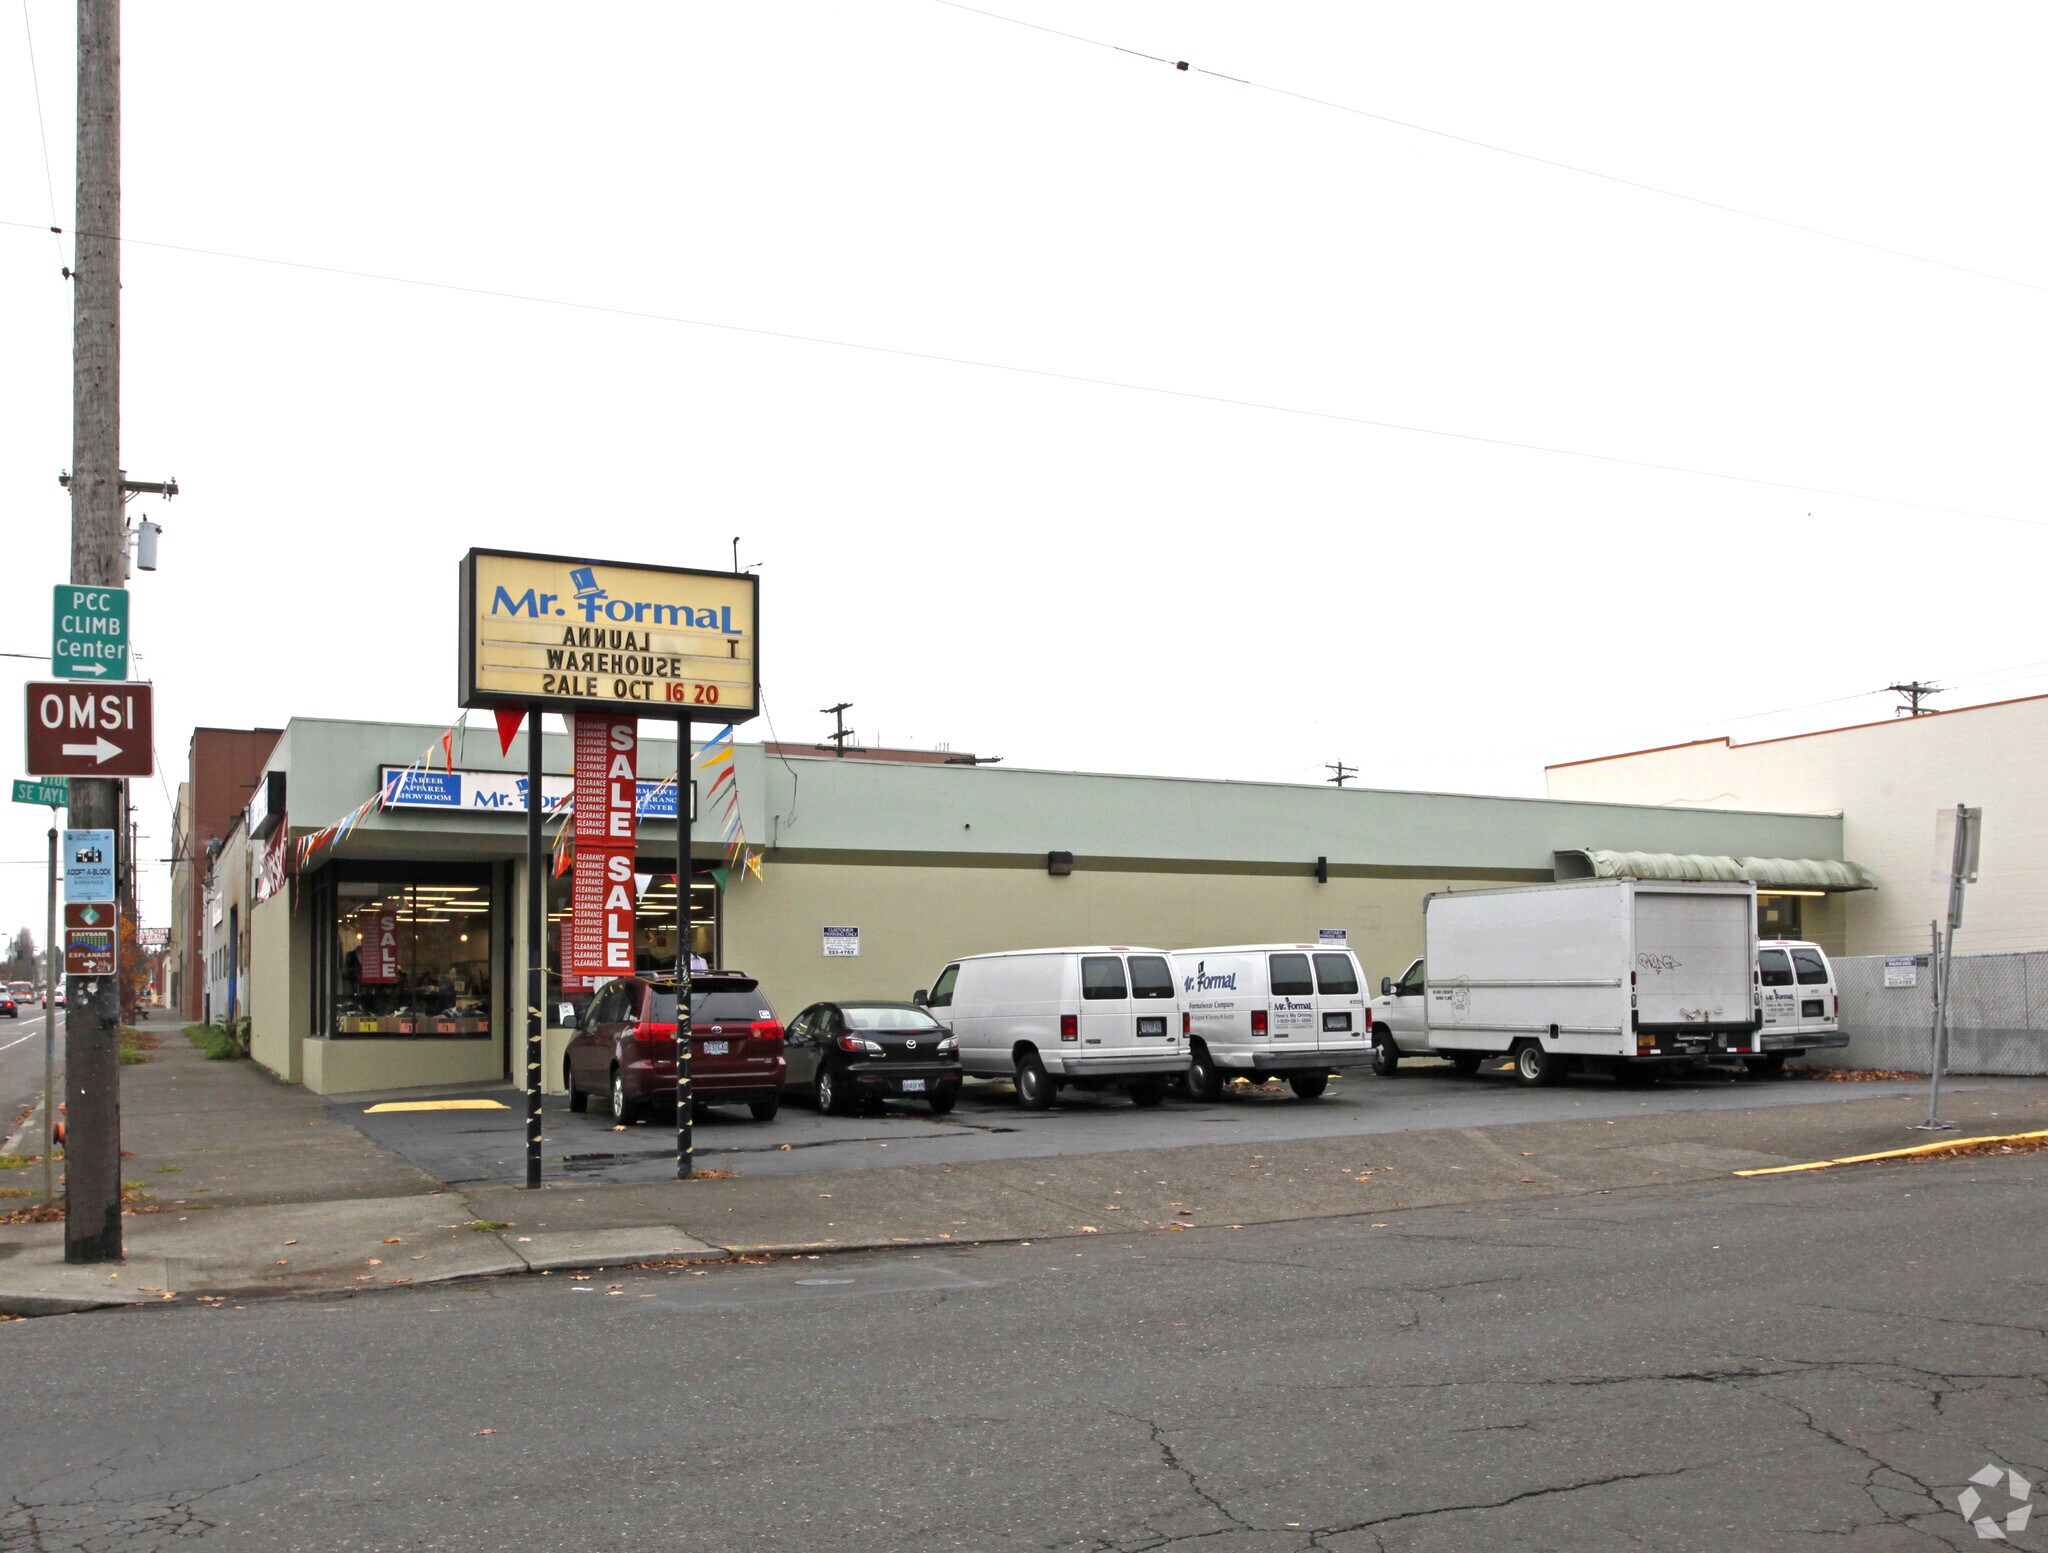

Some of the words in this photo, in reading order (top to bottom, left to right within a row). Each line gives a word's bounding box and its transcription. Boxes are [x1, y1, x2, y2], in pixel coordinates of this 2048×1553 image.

[73, 592, 110, 611] PCC
[491, 586, 566, 618] Mr.
[62, 615, 120, 636] CLIMB
[563, 626, 650, 652] ANNUAL
[727, 639, 739, 659] T
[56, 639, 125, 659] Center
[547, 649, 681, 677] WAREHOUSE
[542, 674, 598, 697] SALE
[614, 678, 653, 701] OCT
[665, 682, 685, 703] 16
[694, 684, 719, 705] 20
[40, 694, 134, 730] OMSI
[577, 722, 607, 730] CLEARANCE
[577, 730, 606, 738] CLEARANCE
[577, 738, 606, 746] CLEARANCE
[577, 755, 606, 763] CLEARANCE
[577, 763, 606, 771] CLEARANCE
[577, 771, 606, 779] CLEARANCE
[577, 779, 606, 787] CLEARANCE
[608, 724, 635, 837] SALE
[403, 785, 446, 793] APPAREL
[577, 787, 606, 795] CLEARANCE
[18, 784, 34, 800] SE
[38, 786, 68, 804] TAYL
[474, 790, 514, 807] Mr.
[577, 795, 606, 803] CLEARANCE
[577, 803, 605, 811] CLEARANCE
[577, 811, 605, 819] CLEARANCE
[577, 828, 605, 836] CLEARANCE
[604, 856, 632, 968] SALE
[381, 916, 396, 977] SALE
[1214, 1001, 1234, 1009] Company
